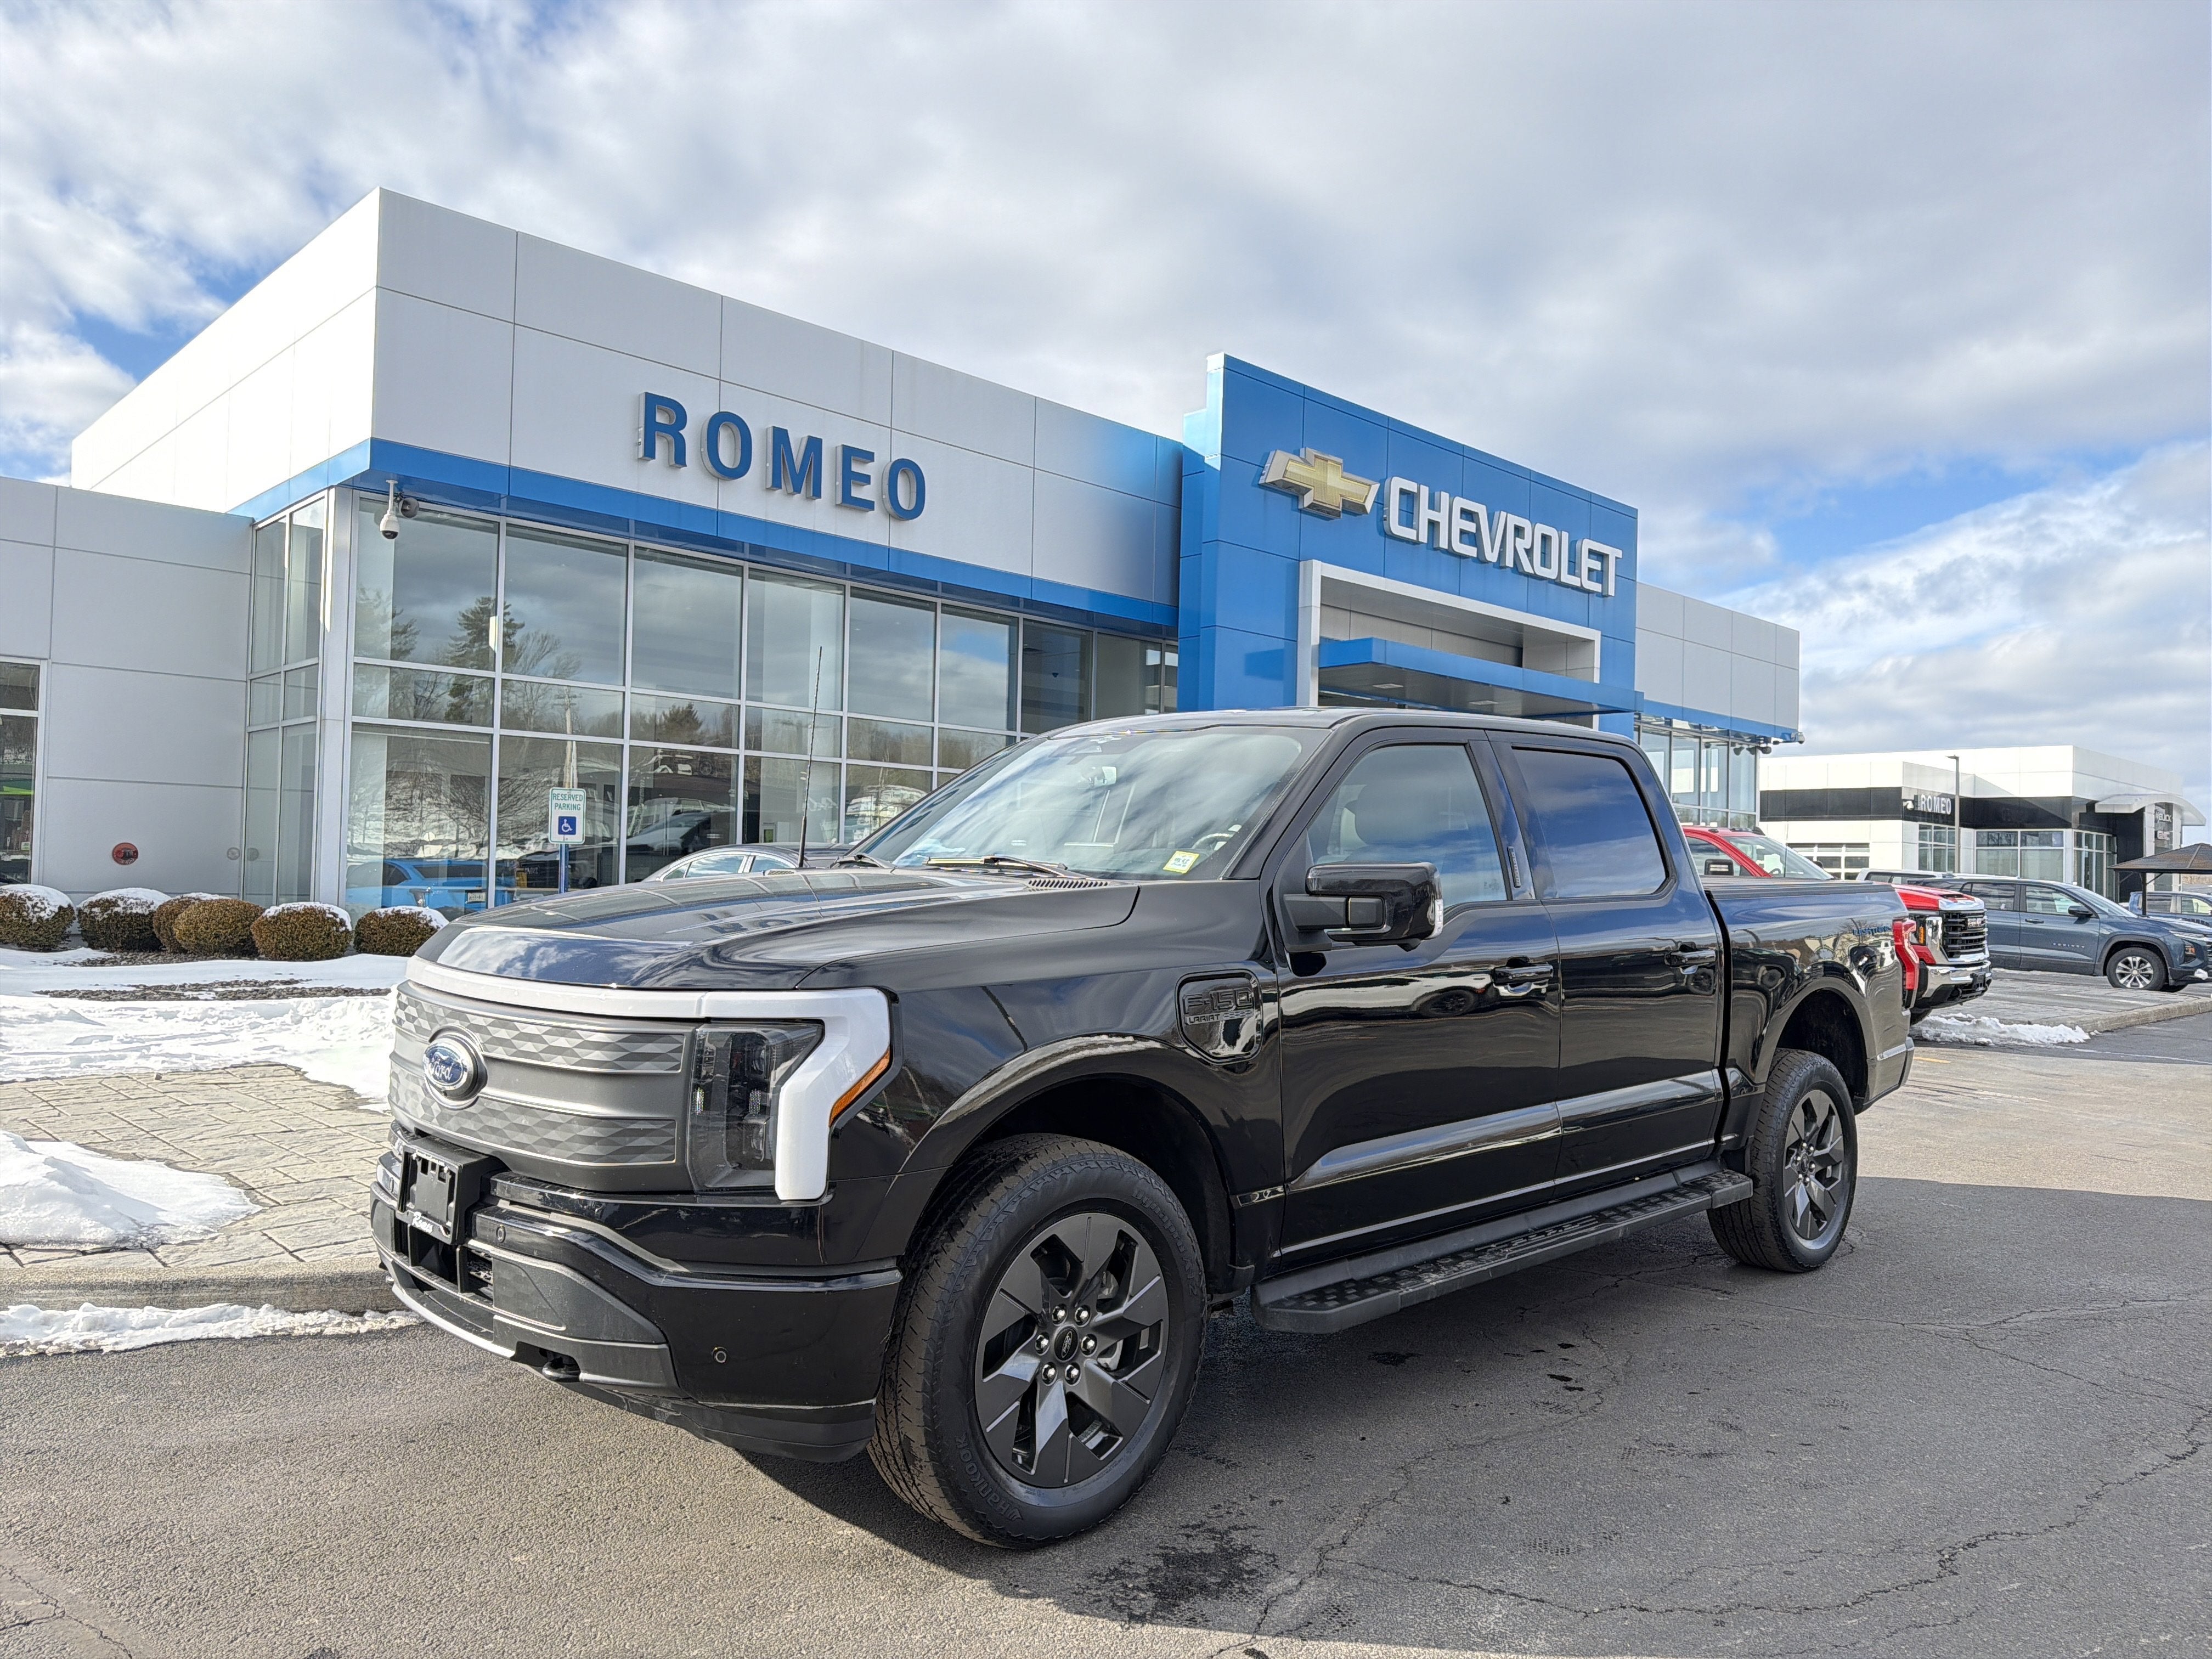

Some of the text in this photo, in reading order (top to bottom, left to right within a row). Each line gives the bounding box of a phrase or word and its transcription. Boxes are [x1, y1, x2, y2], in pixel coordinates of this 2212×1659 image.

[639, 391, 926, 521] ROMEO
[1383, 476, 1623, 597] CHEVROLET
[552, 793, 583, 802] RESERVED
[1920, 794, 1951, 815] ROMEO
[1182, 988, 1254, 1014] F-150
[1189, 1013, 1220, 1023] LARIAT
[428, 1051, 454, 1081] Ford
[1132, 1188, 1185, 1253] Dynapro
[955, 1432, 1011, 1515] Hankook
